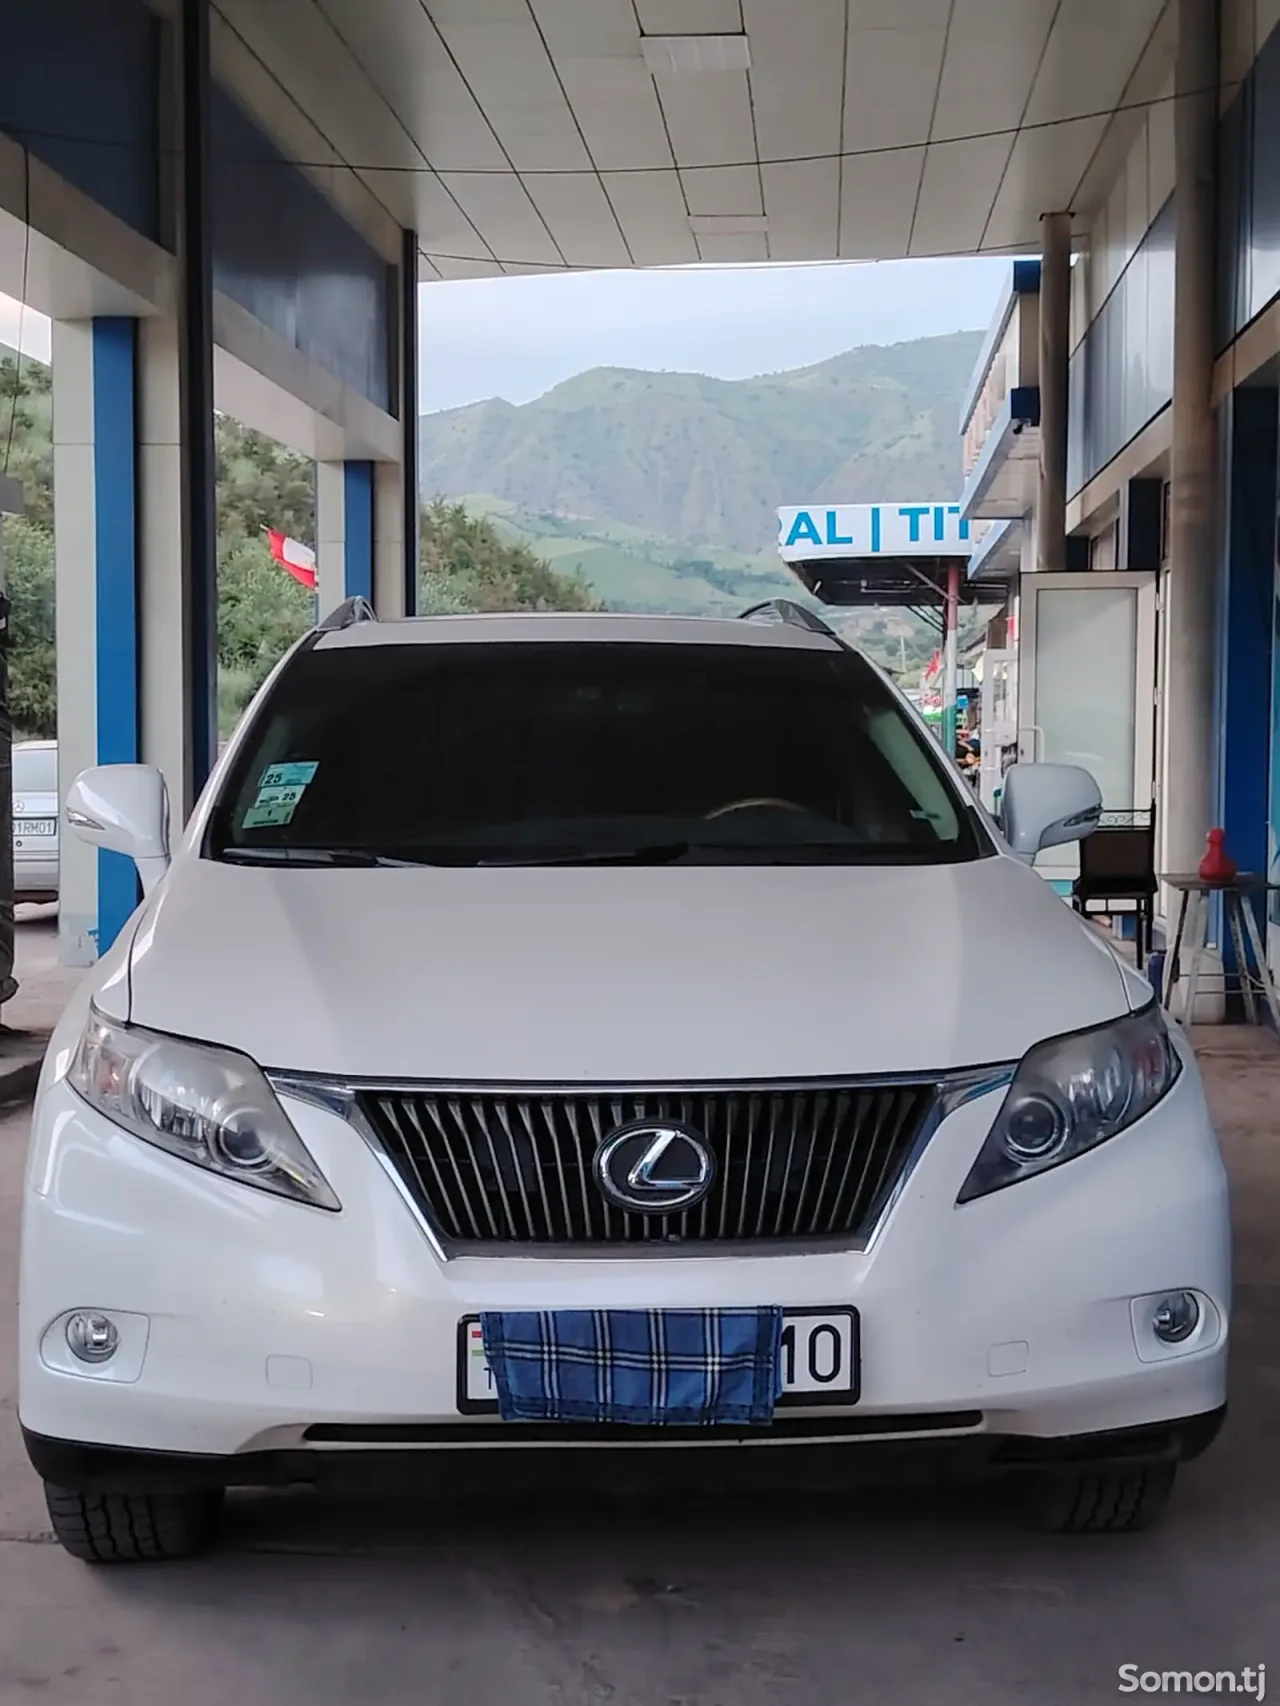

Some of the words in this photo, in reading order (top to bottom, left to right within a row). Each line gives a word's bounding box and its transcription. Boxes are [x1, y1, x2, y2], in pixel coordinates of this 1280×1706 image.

[779, 511, 853, 545] AL
[264, 773, 283, 785] 25
[780, 1324, 842, 1384] 10
